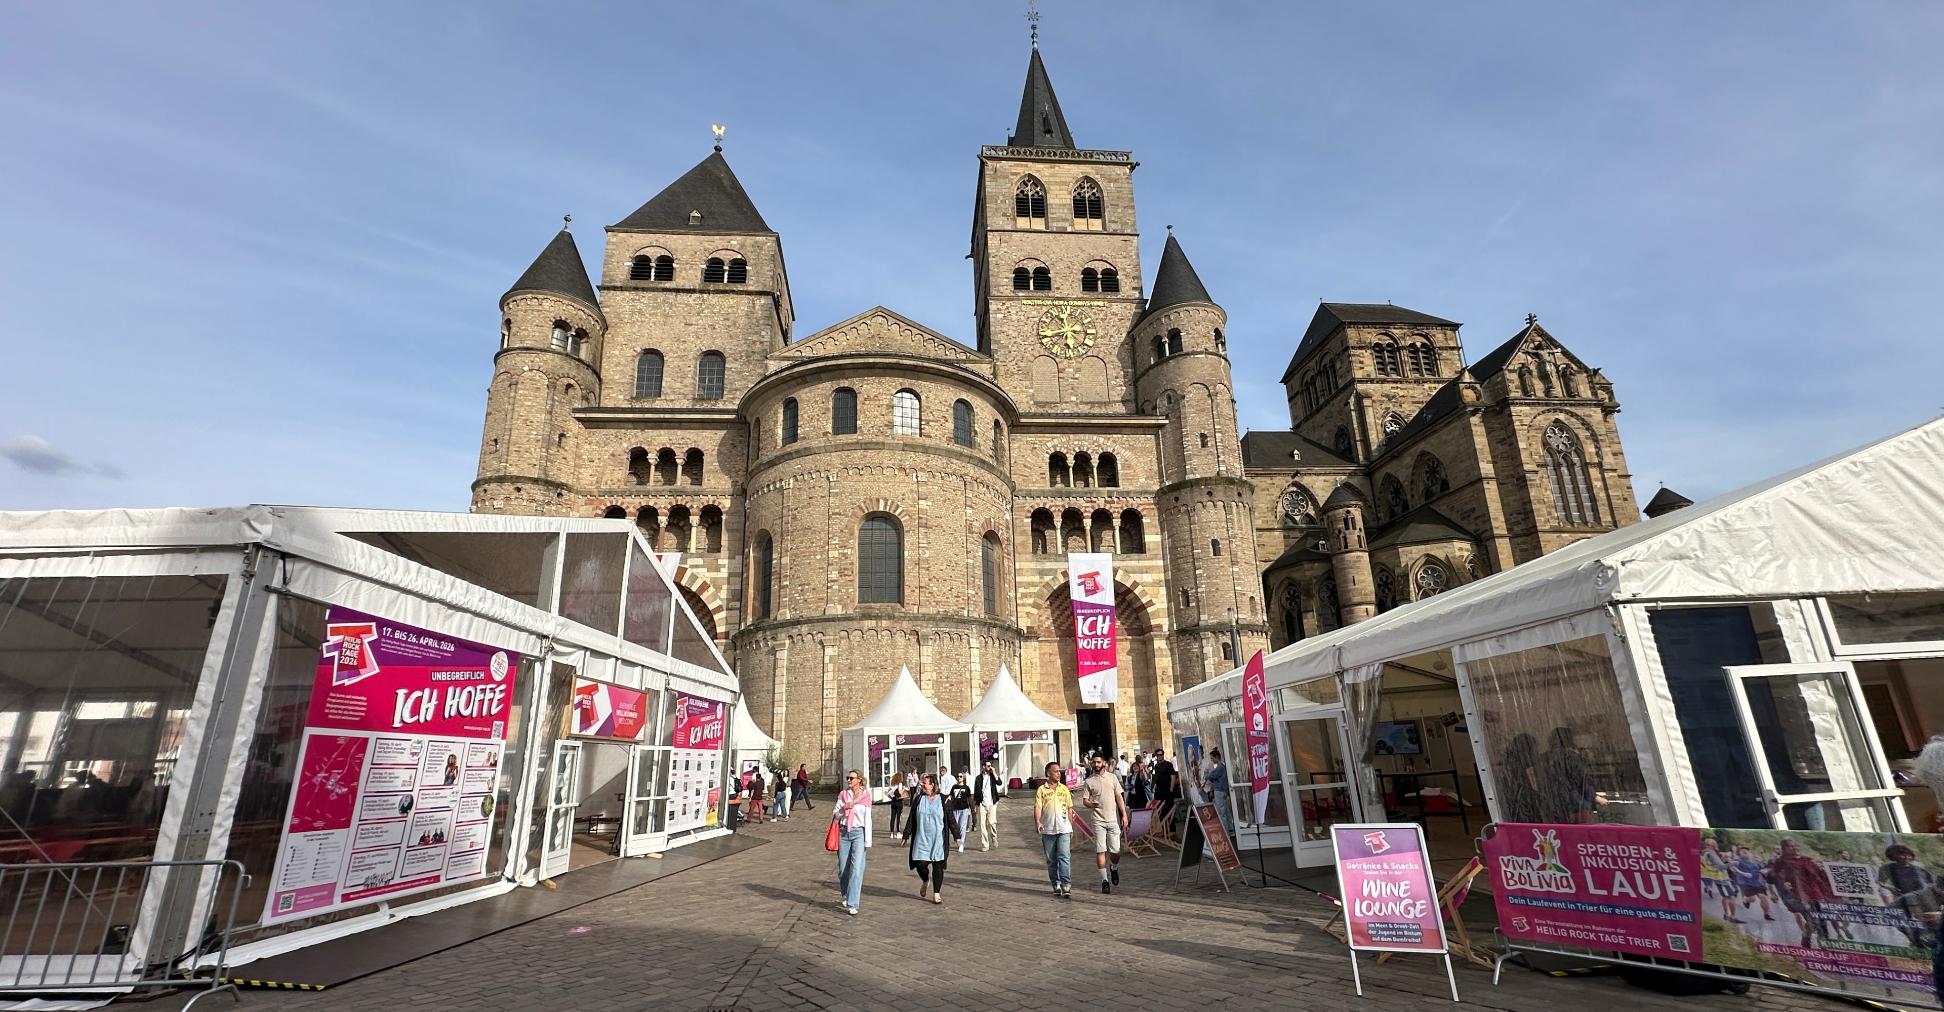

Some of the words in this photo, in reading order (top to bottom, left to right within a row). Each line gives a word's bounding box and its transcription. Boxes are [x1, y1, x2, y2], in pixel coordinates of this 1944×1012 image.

[1077, 615, 1112, 637] ICH
[343, 642, 360, 650] ROCK
[382, 626, 393, 637] 17.
[394, 630, 407, 640] BIS
[408, 633, 419, 644] 26.
[419, 636, 439, 648] APRIL
[440, 641, 455, 652] 2026
[340, 656, 358, 665] 2026
[342, 649, 359, 658] TAGE
[432, 670, 485, 681] UNBEGREIFLICH
[392, 688, 439, 728] ICH
[444, 684, 507, 719] HOFFE
[690, 726, 702, 746] ICH
[703, 720, 722, 740] HOFFE
[1577, 844, 1659, 858] SPENDEN-
[1664, 847, 1677, 859] &
[1581, 856, 1681, 873] INKLUSIONS
[1362, 878, 1410, 898] WINE
[1583, 869, 1685, 901] LAUF
[1354, 898, 1428, 919] LOUNGE
[1509, 896, 1525, 904] Dein
[1527, 898, 1565, 909] Laufevent
[1577, 903, 1598, 912] Trier
[1600, 905, 1612, 914] für
[1636, 909, 1657, 919] gute
[1658, 912, 1692, 922] Sache!
[1820, 902, 1848, 912] MEHR
[1850, 905, 1882, 915] INFOS
[1886, 907, 1905, 916] AUF
[1536, 926, 1567, 937] HEILIG
[1569, 930, 1596, 940] ROCK
[1598, 933, 1625, 944] TAGE
[1627, 937, 1661, 948] TRIER
[1820, 940, 1892, 954] KINDERLAUF
[1759, 944, 1849, 962] INKLUSIONSLAUF
[1808, 963, 1927, 983] ERWACHSENENLAUF
